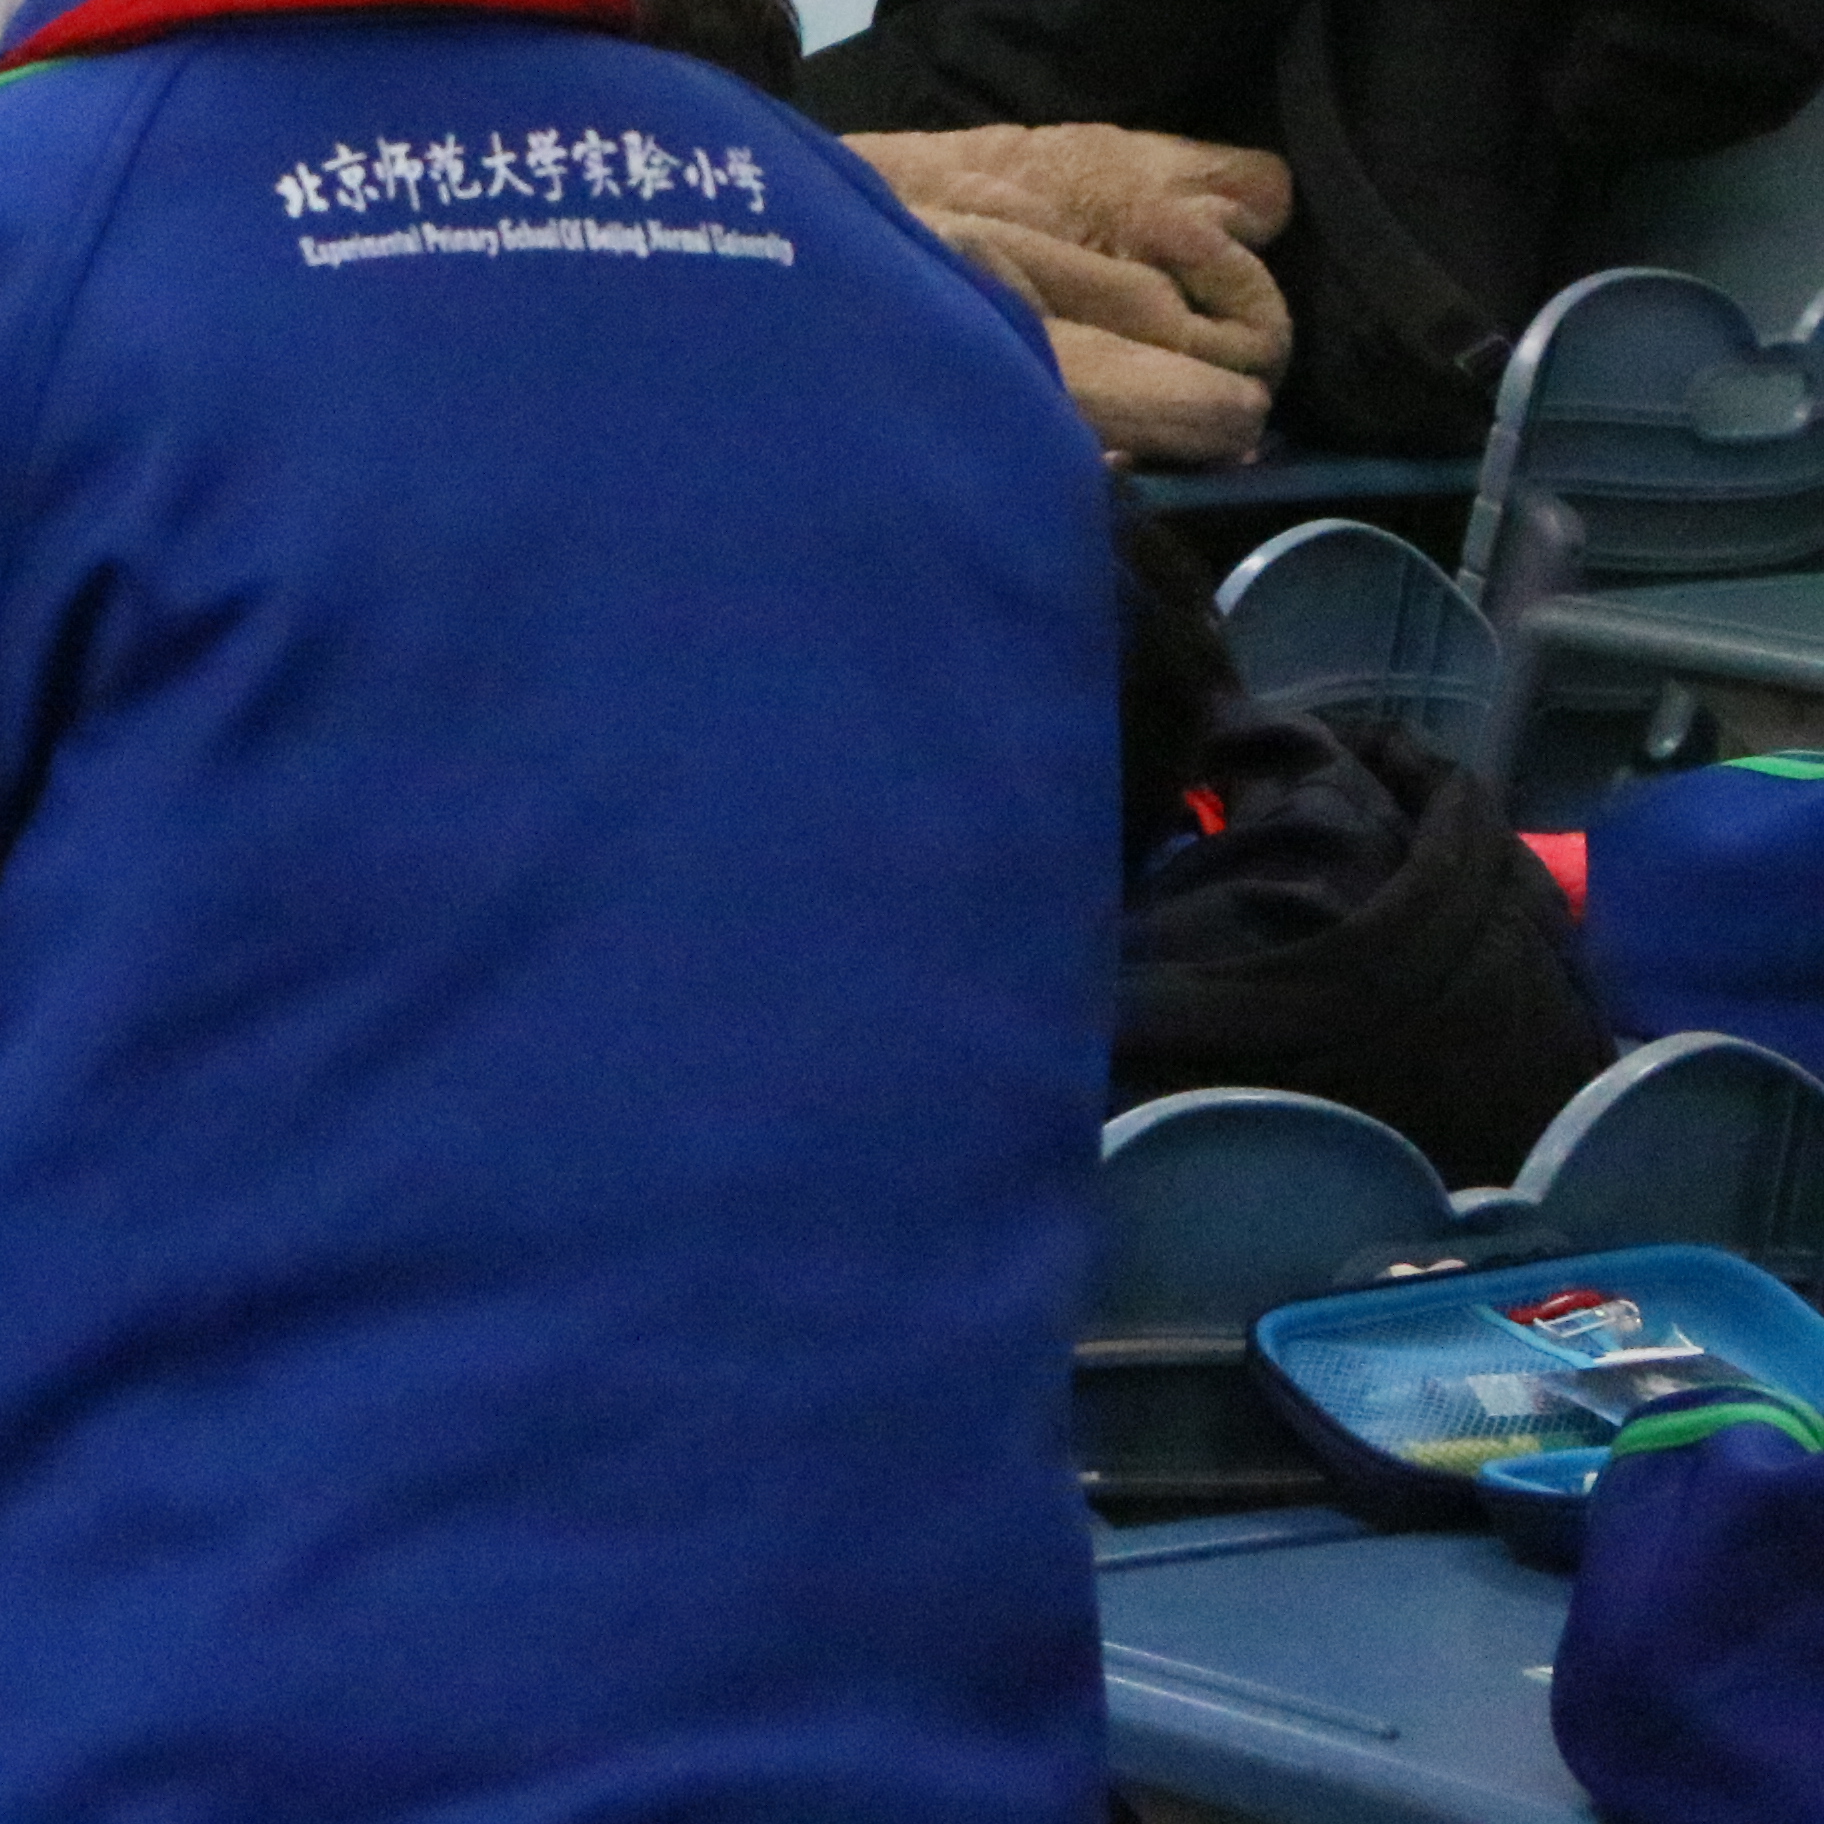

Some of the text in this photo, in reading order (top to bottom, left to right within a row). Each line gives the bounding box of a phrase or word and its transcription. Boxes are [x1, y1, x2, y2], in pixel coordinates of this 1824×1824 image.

[274, 128, 767, 219] 北京师范大学实验小学
[422, 221, 500, 258] Primary
[498, 218, 559, 251] School
[583, 217, 650, 258] Beijing
[647, 219, 712, 253] Normal
